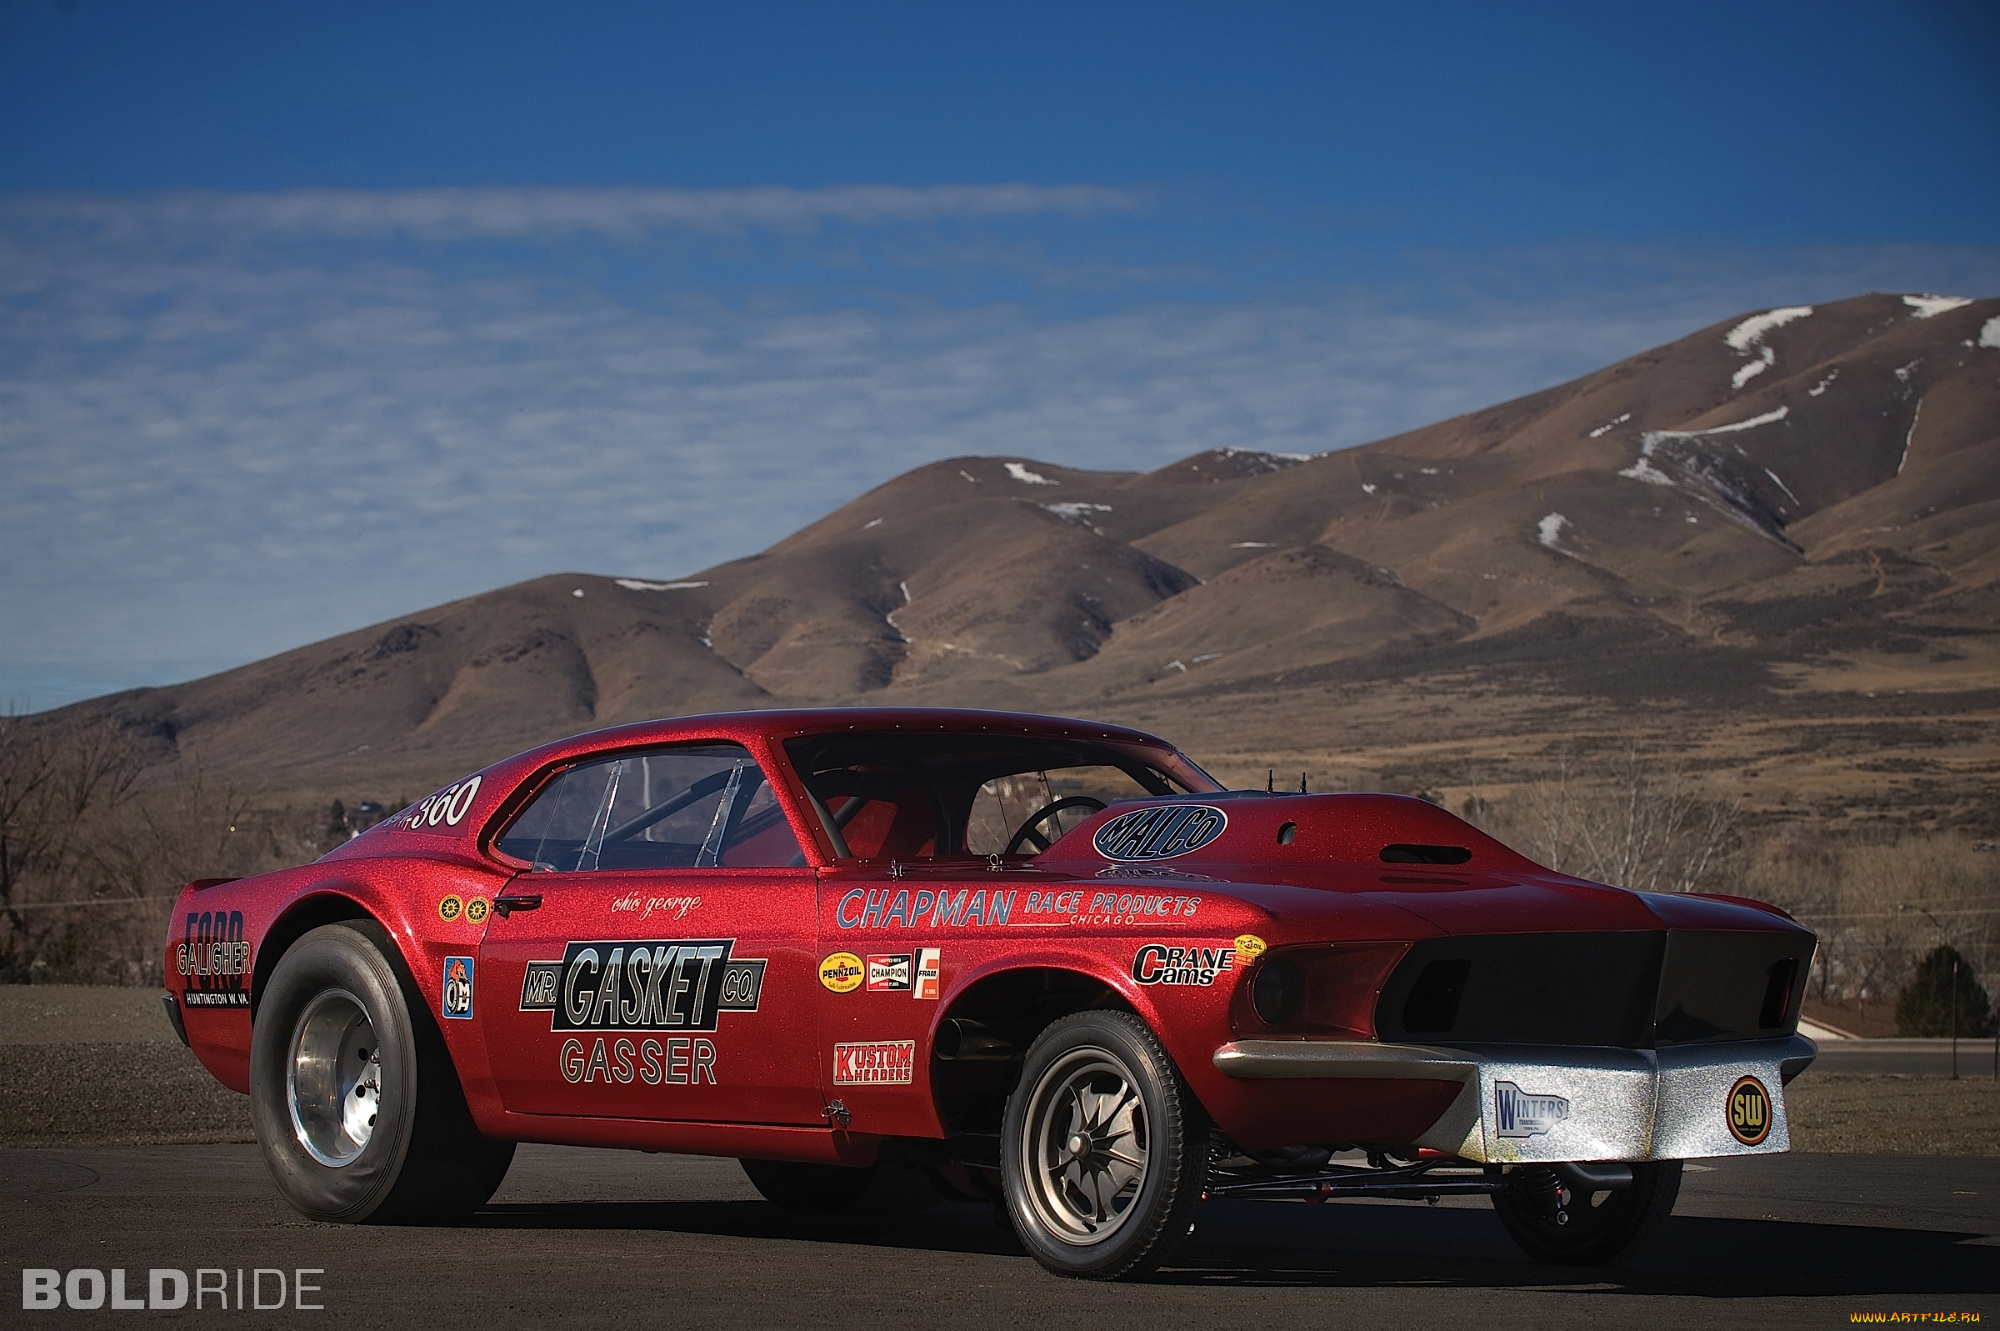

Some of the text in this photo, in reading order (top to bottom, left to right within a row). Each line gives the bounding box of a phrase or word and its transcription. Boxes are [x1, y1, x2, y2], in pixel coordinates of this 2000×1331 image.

[411, 775, 482, 830] 360
[1099, 807, 1219, 858] MALCO
[639, 896, 702, 921] george
[836, 889, 1202, 929] CHAPMAN RACE PRODUCTS
[1070, 914, 1135, 925] CHICAGO
[177, 941, 251, 976] GALIGHER
[822, 966, 862, 980] PENNZOIL
[871, 968, 907, 978] CHAMPION
[186, 992, 228, 1005] HUNTINGTON
[228, 993, 238, 1004] W.
[526, 946, 754, 1025] MR. GASKET CO.
[560, 1038, 717, 1085] GASSER
[836, 1044, 913, 1082] KUSTOM
[855, 1069, 911, 1082] HEADERS
[1498, 1089, 1564, 1130] WINTERS
[1734, 1093, 1763, 1126] SW
